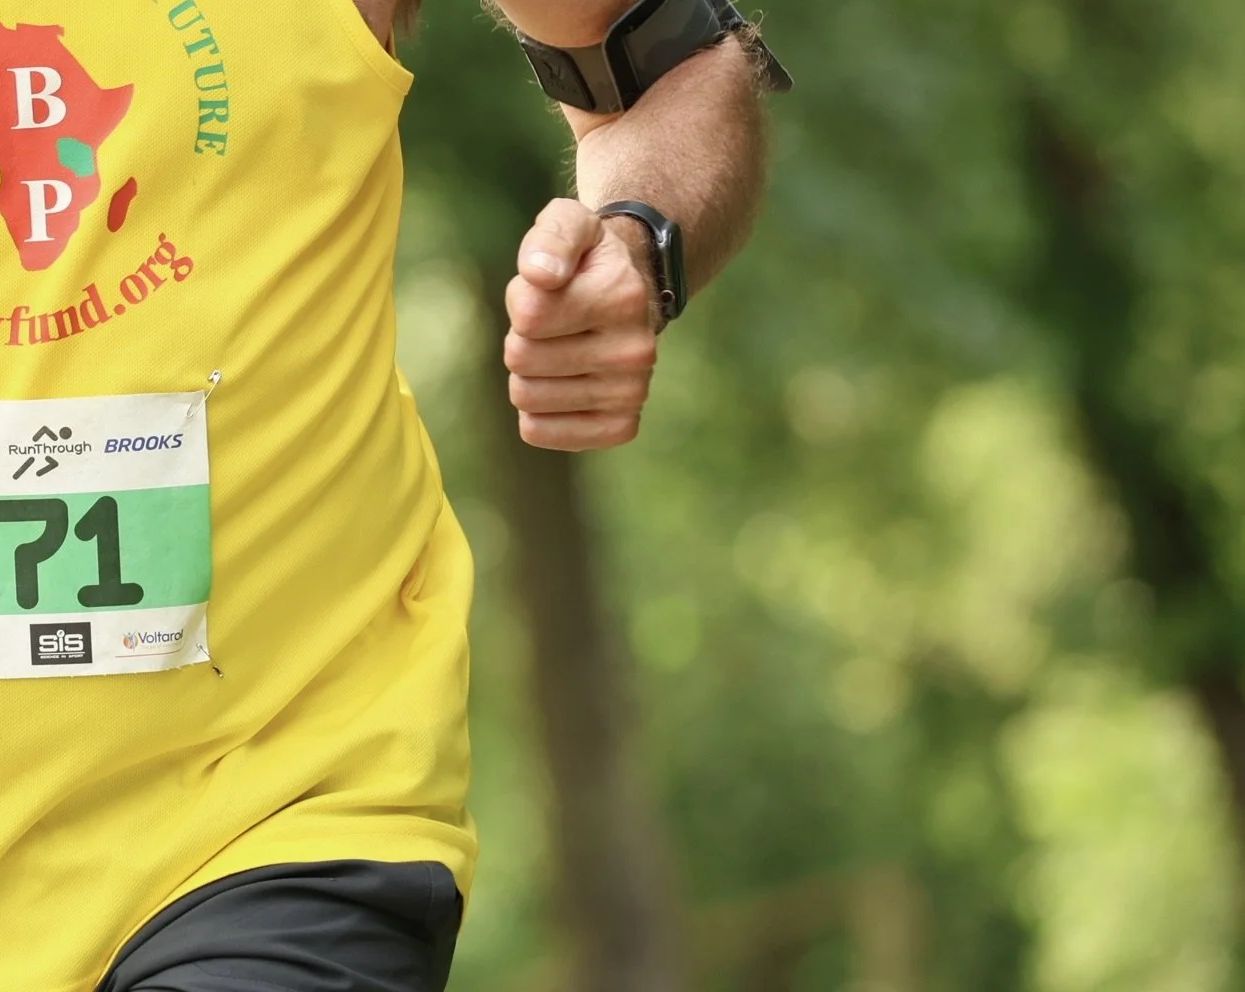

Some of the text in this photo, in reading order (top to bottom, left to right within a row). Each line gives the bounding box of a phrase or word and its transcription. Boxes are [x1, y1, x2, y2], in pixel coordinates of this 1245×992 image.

[6, 66, 68, 130] B
[20, 179, 74, 243] P
[8, 440, 92, 456] RunThrough
[104, 433, 184, 454] BROOKS
